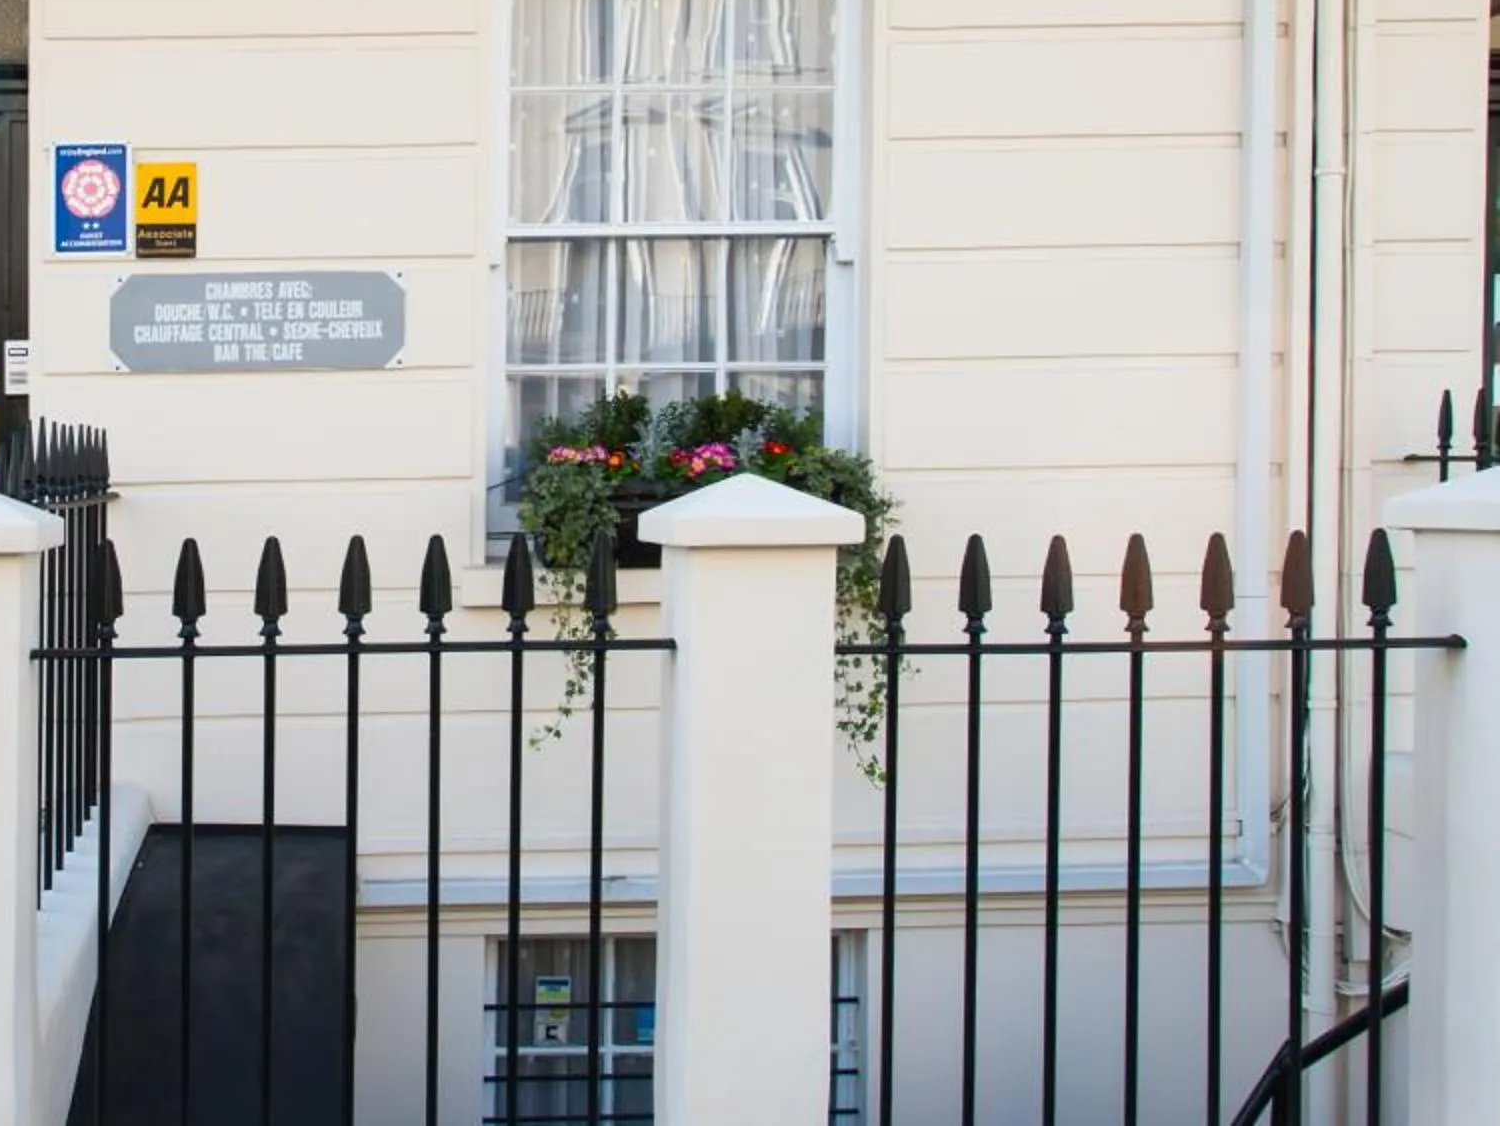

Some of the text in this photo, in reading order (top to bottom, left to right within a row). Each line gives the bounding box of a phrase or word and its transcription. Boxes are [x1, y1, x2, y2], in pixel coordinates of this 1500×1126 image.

[141, 176, 190, 209] AA
[205, 282, 273, 300] CHAMBRES
[253, 302, 283, 320] TELE
[287, 302, 304, 319] EN
[308, 300, 363, 319] COULEUR
[133, 320, 383, 344] CHAUFFAGE CENTRAL SECHE-CHEVEUX
[214, 342, 304, 363] BAR THE CAFE
